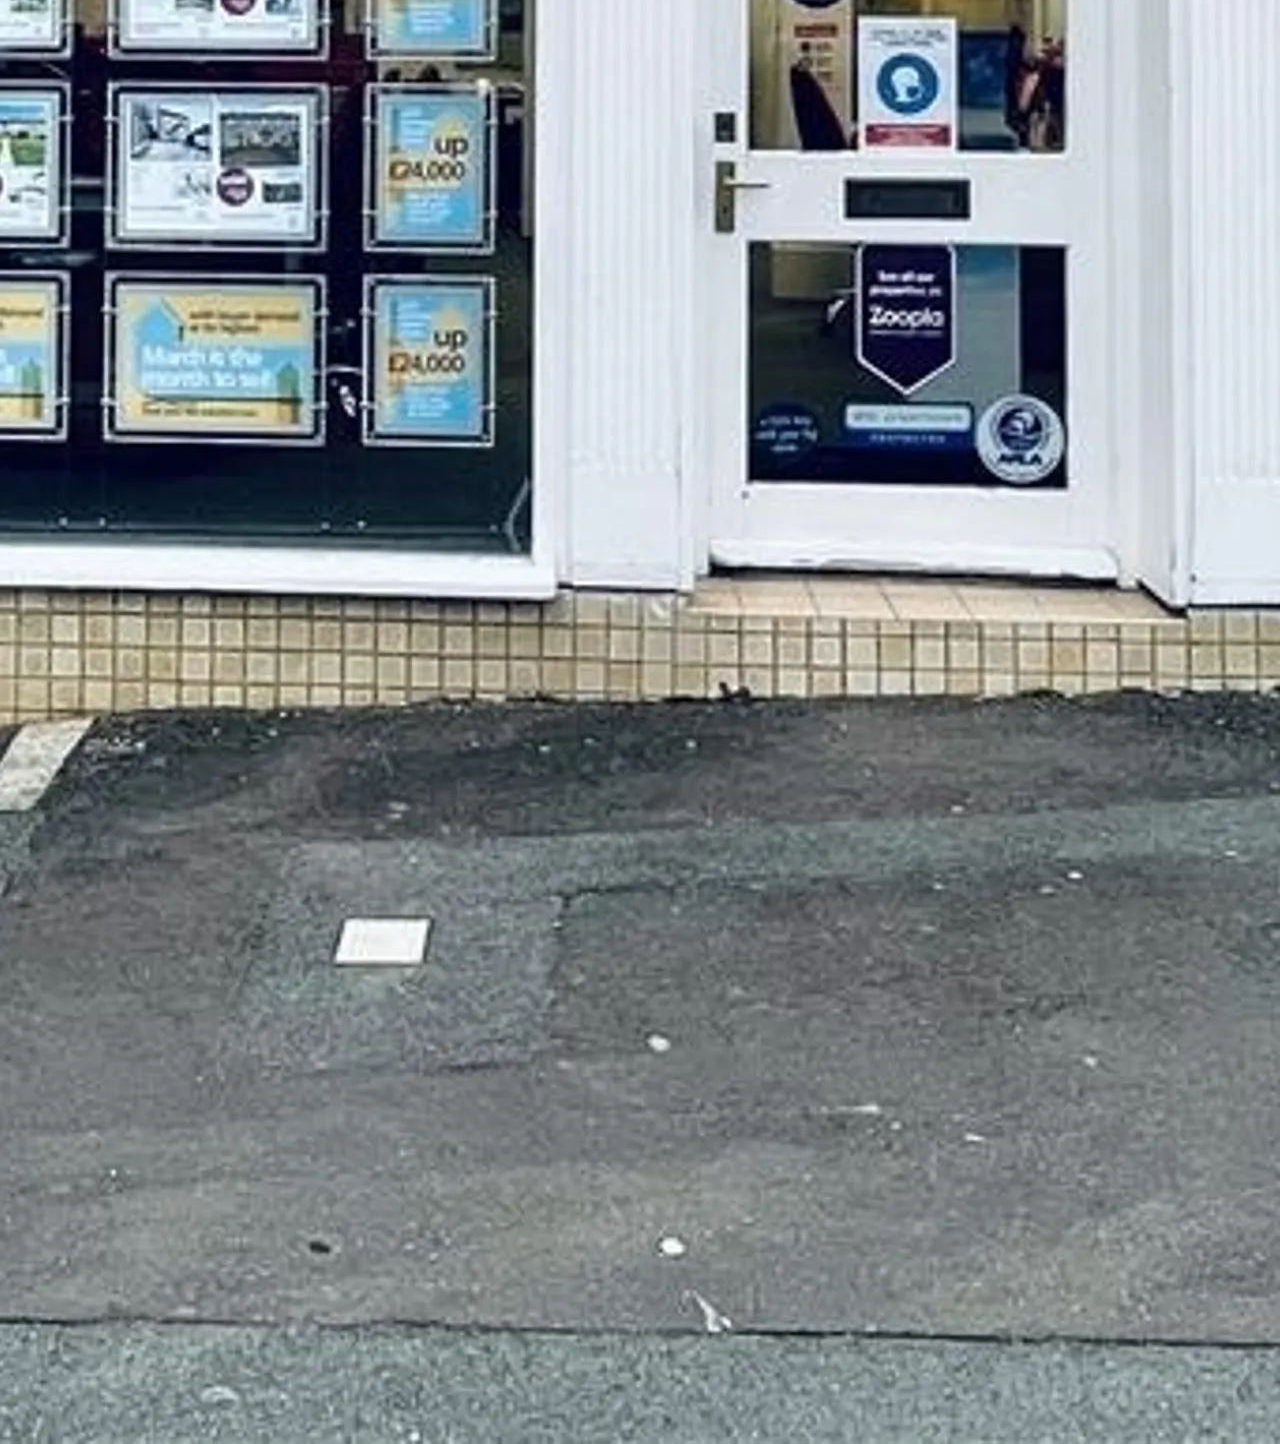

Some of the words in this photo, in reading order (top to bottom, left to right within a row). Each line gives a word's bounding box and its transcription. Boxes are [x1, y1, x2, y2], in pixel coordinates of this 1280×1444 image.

[434, 137, 468, 158] up
[389, 161, 466, 182] £24,000
[868, 303, 945, 330] Zoopla
[433, 329, 467, 350] up
[388, 353, 466, 373] £24,000
